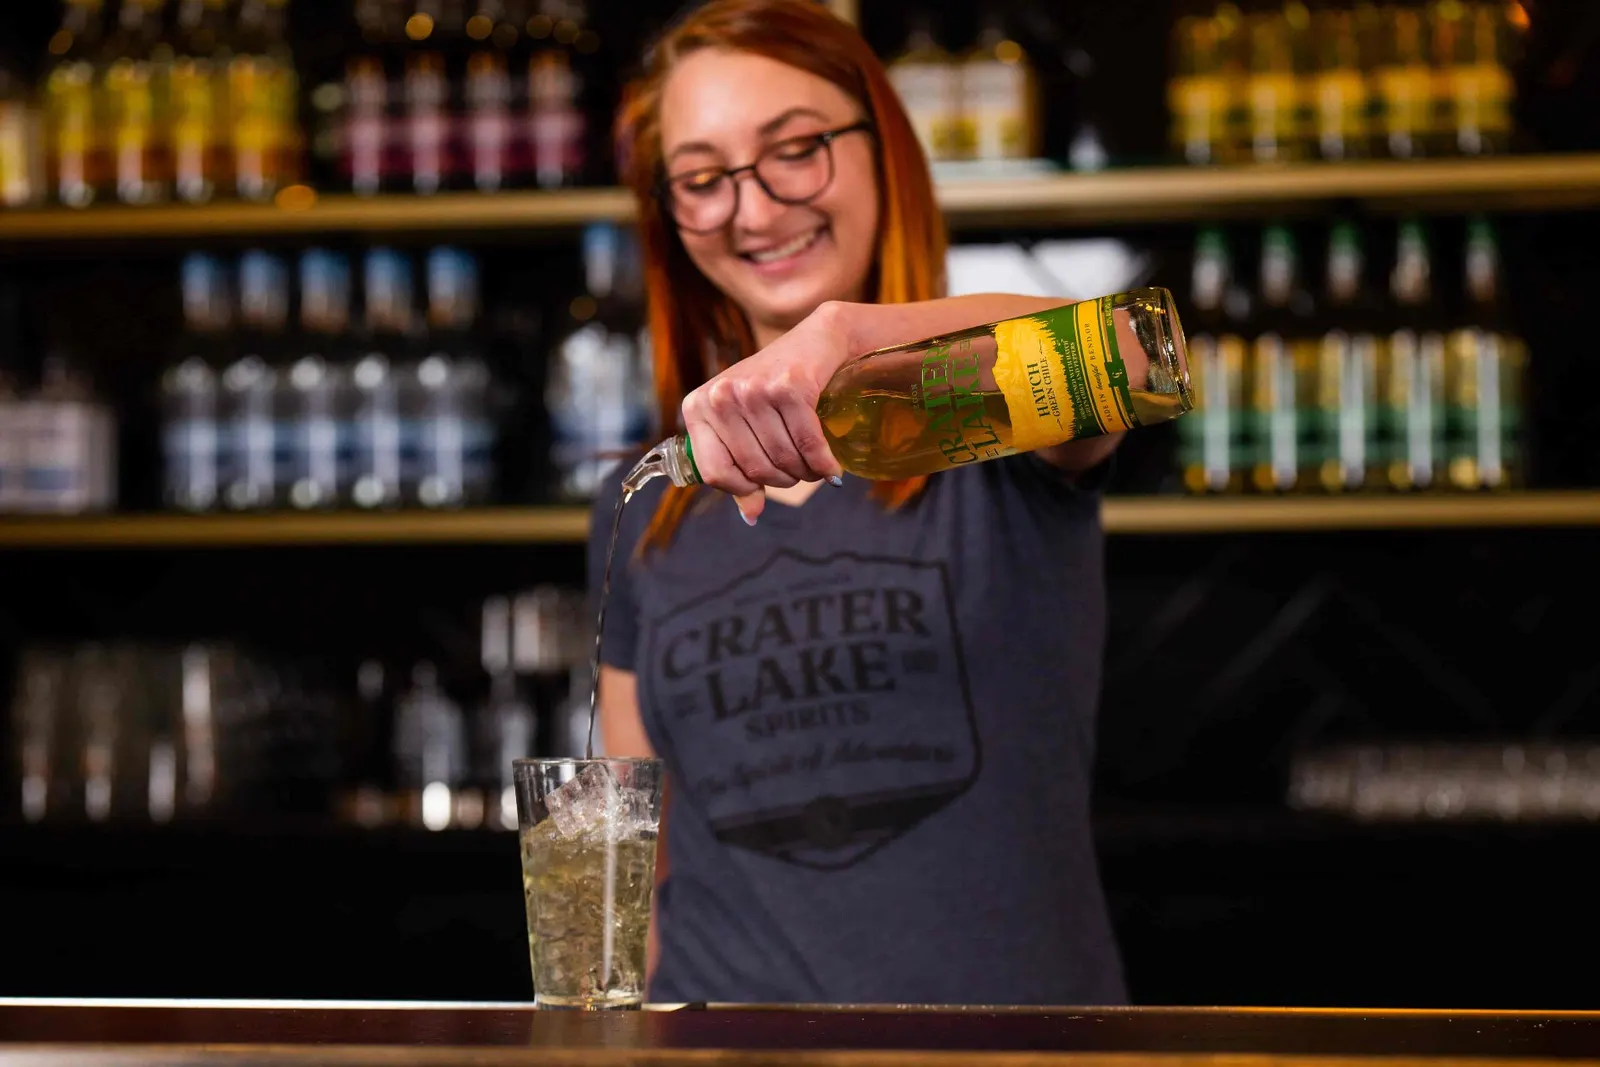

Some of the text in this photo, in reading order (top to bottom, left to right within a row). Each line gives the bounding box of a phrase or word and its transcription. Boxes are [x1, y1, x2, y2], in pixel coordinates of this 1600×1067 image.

[922, 343, 979, 464] CRATER
[952, 353, 1002, 450] LAKE
[1027, 363, 1050, 417] HATCH
[1040, 356, 1060, 417] GREEN CHILE
[1099, 394, 1106, 403] IN
[661, 587, 931, 680] CRATER
[704, 641, 896, 720] LAKE
[744, 702, 871, 741] SPIRITS
